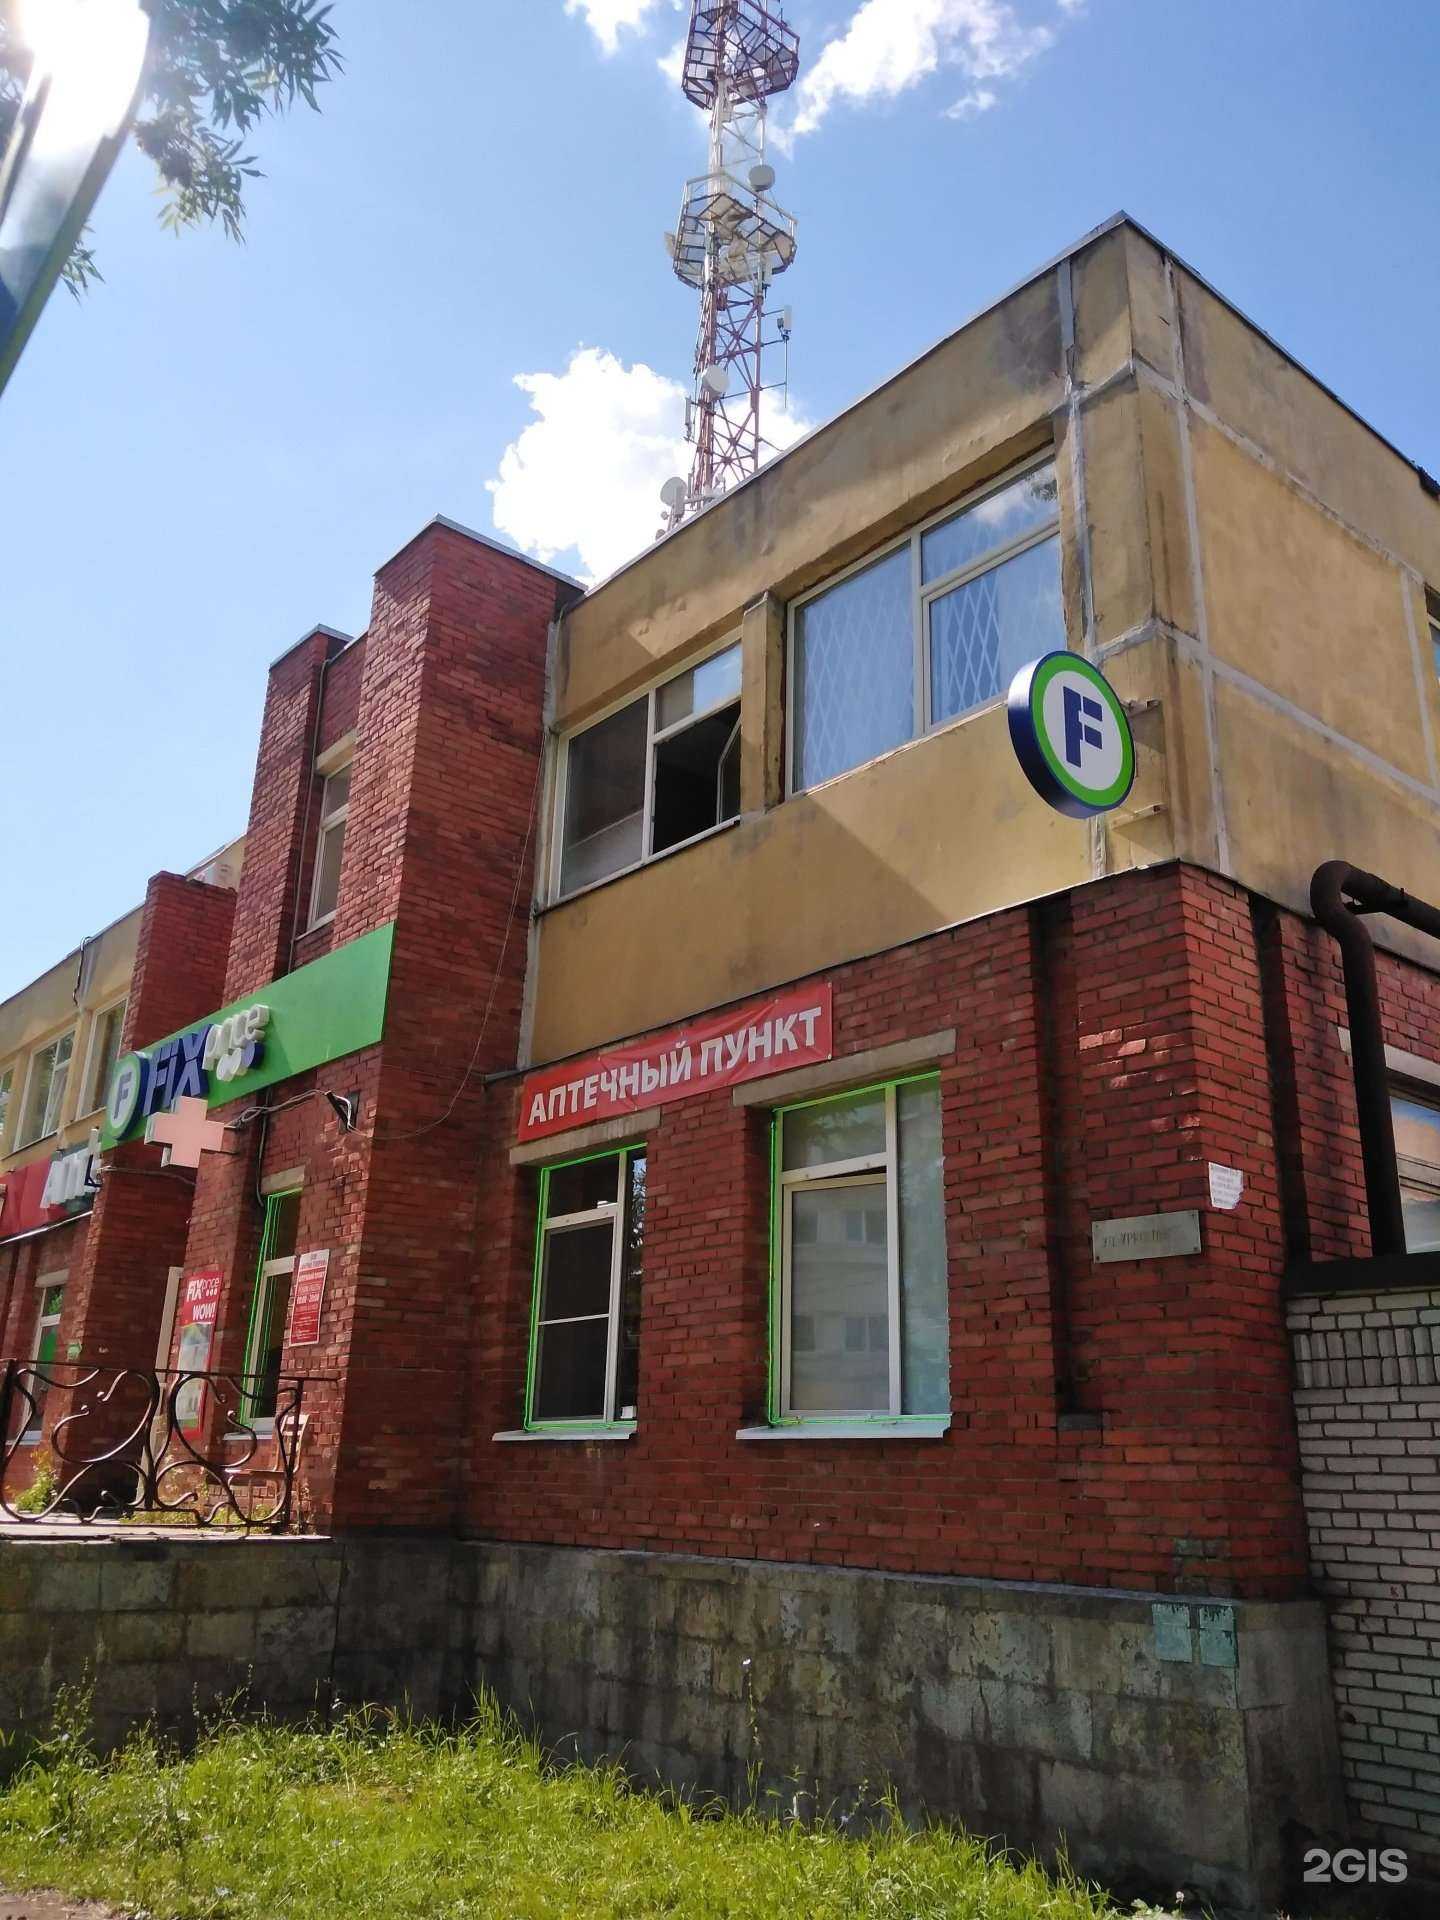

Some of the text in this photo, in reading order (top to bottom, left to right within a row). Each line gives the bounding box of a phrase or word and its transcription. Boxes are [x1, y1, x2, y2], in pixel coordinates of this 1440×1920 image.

[1063, 686, 1103, 768] F
[143, 1024, 214, 1117] FIX
[527, 1006, 822, 1126] АПТЕЧНЫЙ ПУНКТ
[186, 1279, 205, 1302] FIX
